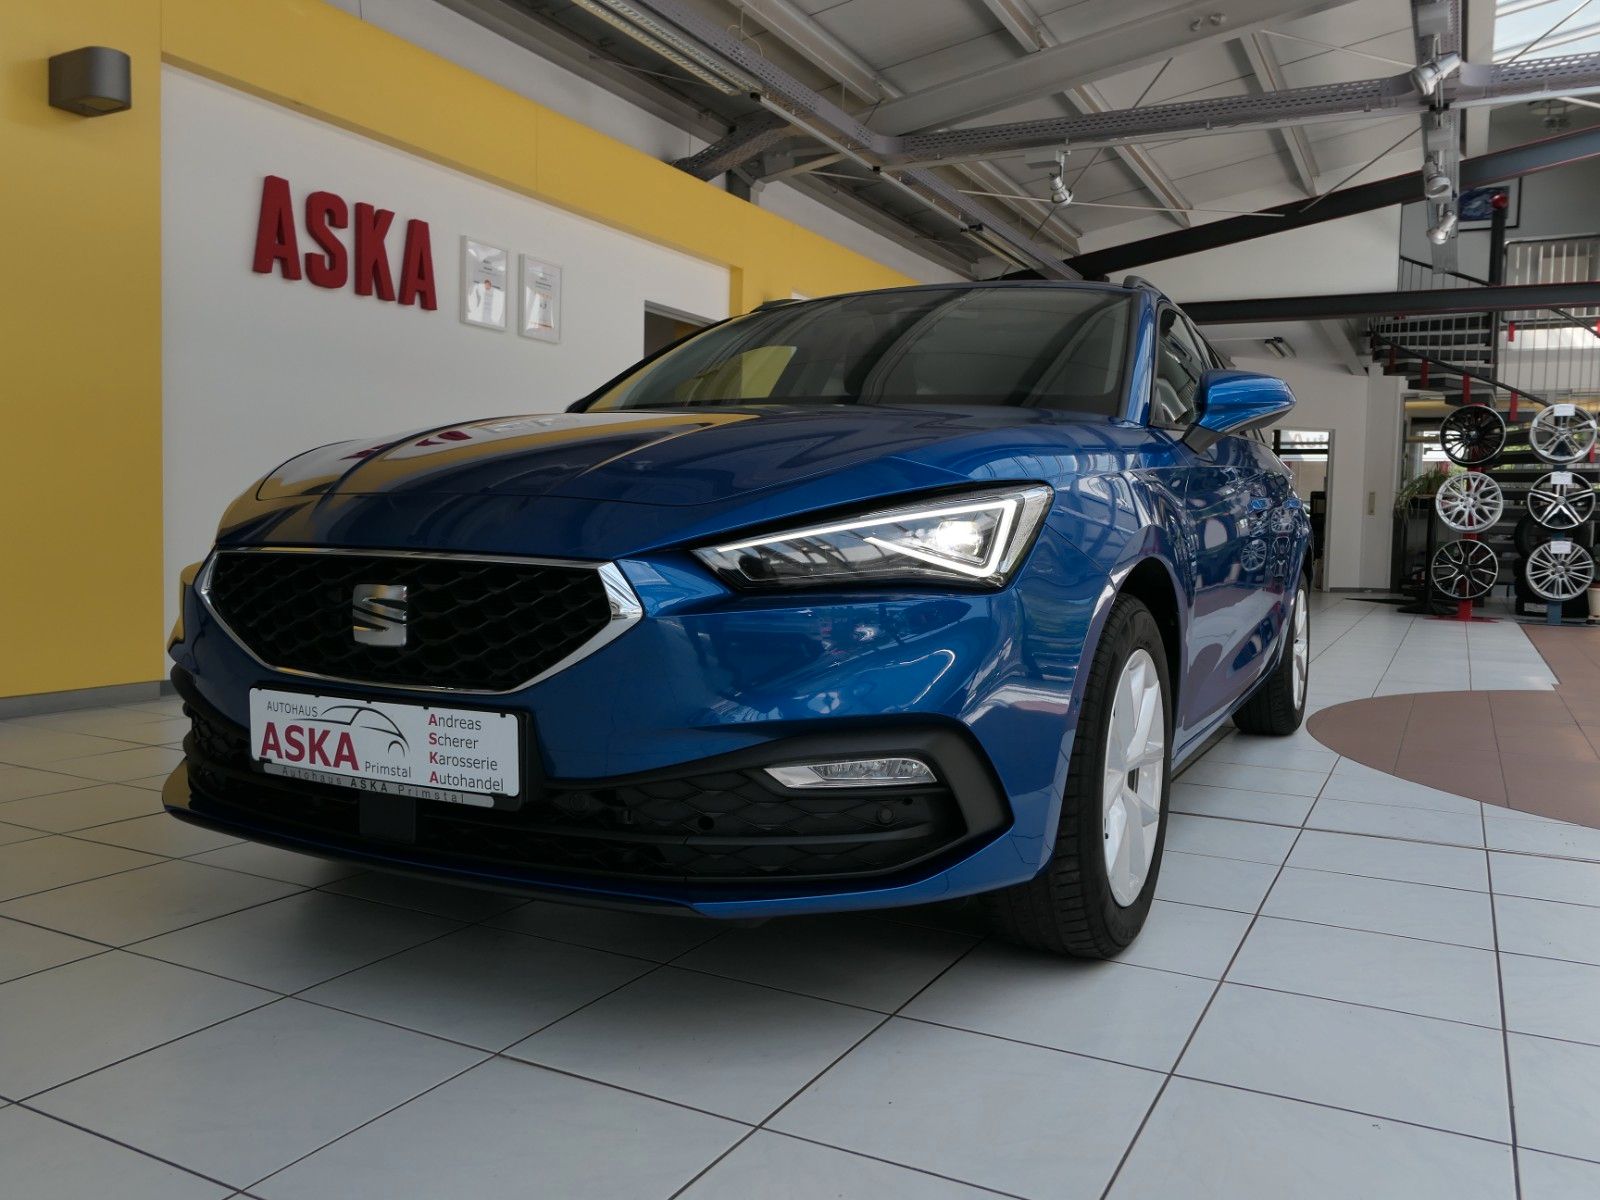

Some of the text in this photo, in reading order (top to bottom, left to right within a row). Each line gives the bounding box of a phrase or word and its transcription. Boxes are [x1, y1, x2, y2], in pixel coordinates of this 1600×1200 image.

[252, 175, 438, 311] ASKA
[266, 701, 319, 718] AUTOHAUS
[428, 713, 482, 731] Andreas
[260, 721, 360, 771] ASKA
[428, 732, 479, 749] Scherer
[365, 761, 412, 778] Primstal
[429, 751, 498, 771] Karosserie
[282, 766, 464, 804] Autohaus ASKA Primstal
[429, 771, 504, 792] Autohandel
